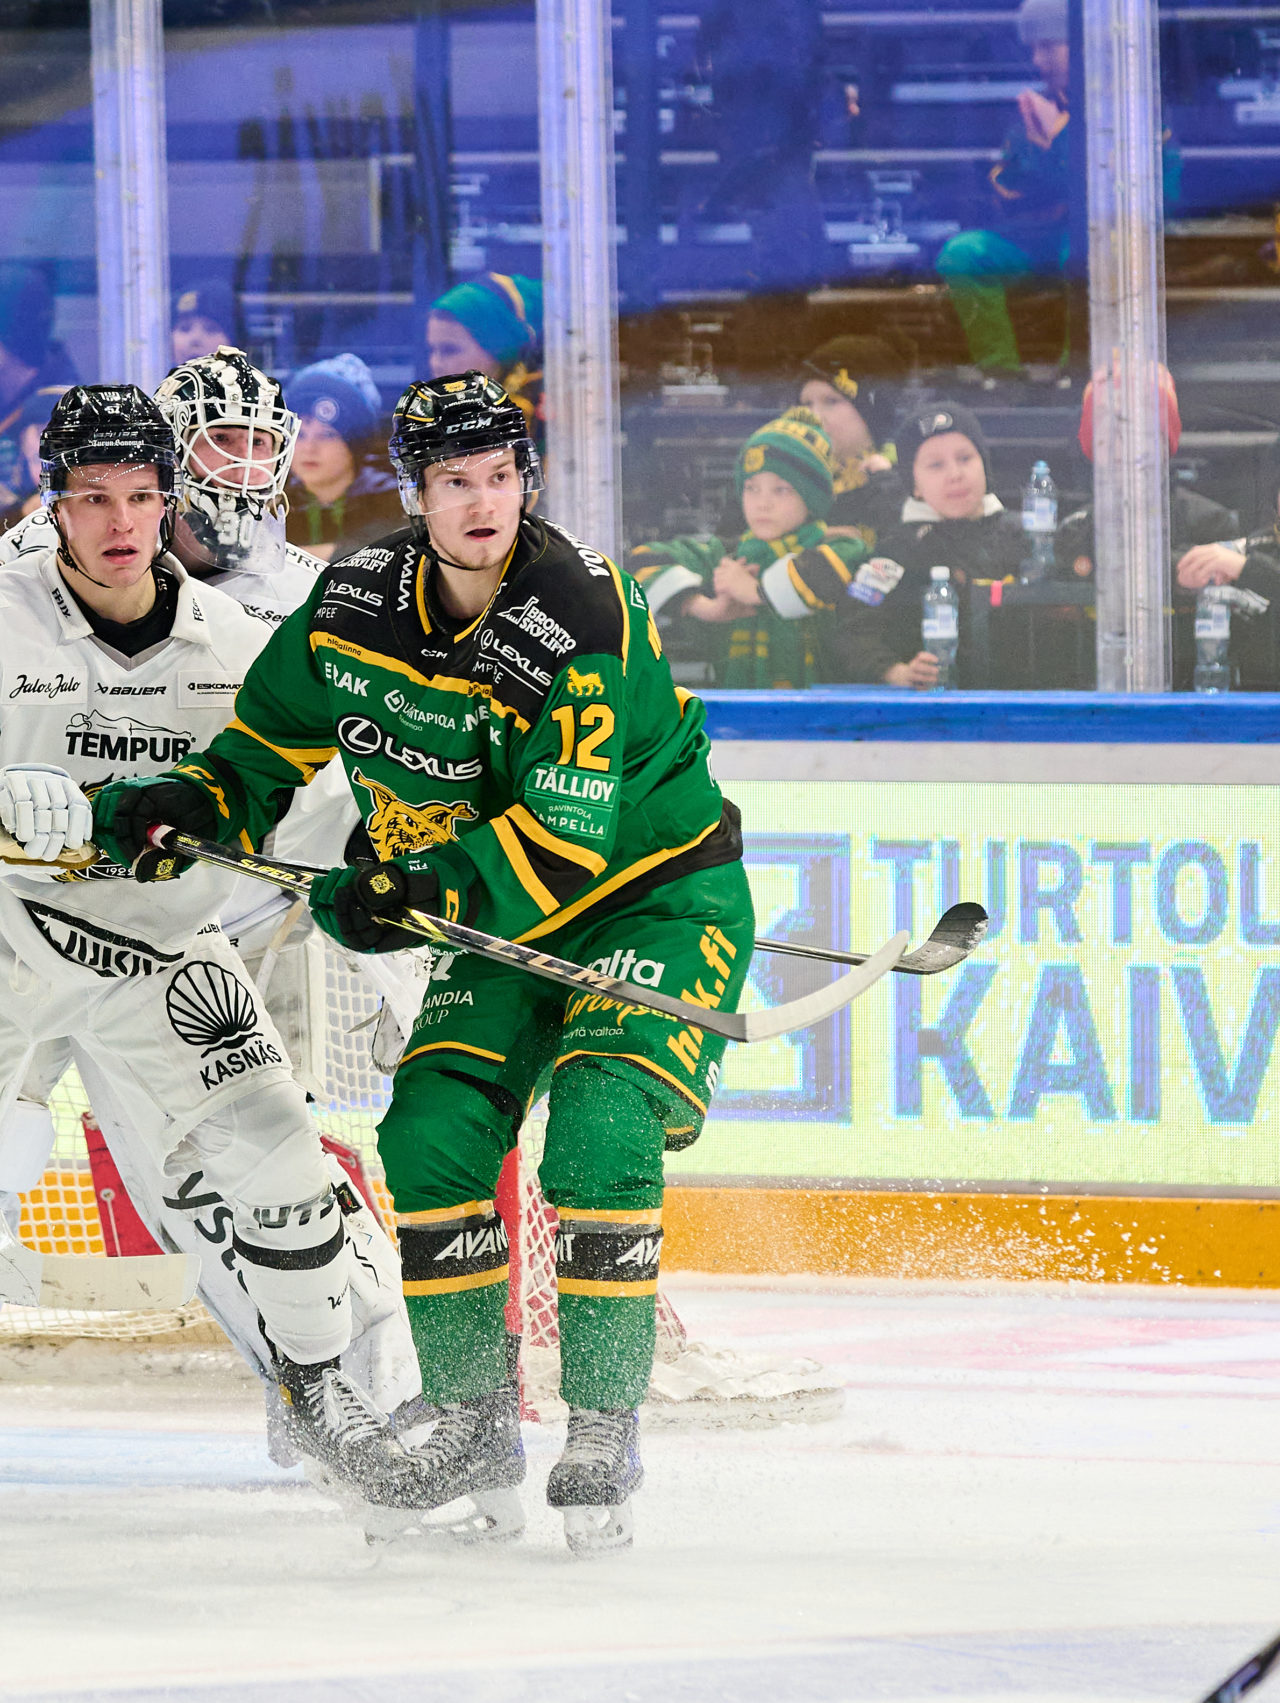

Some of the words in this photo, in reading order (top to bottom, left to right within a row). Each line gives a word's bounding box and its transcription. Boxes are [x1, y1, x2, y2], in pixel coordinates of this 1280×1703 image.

[446, 417, 493, 434] CCM
[217, 511, 254, 548] 30
[333, 583, 384, 607] LEXUS
[527, 606, 576, 651] BRONTO
[493, 639, 553, 687] LEXUS
[109, 686, 167, 696] BAUER
[65, 731, 192, 763] TEMPUR
[551, 703, 615, 772] 12
[385, 736, 483, 780] LEXUS
[534, 766, 615, 802] TÄLLIOY
[548, 804, 592, 820] RAVINTOLA
[239, 858, 297, 884] SUPER
[588, 949, 666, 989] alta
[200, 1040, 282, 1091] KASNÄS
